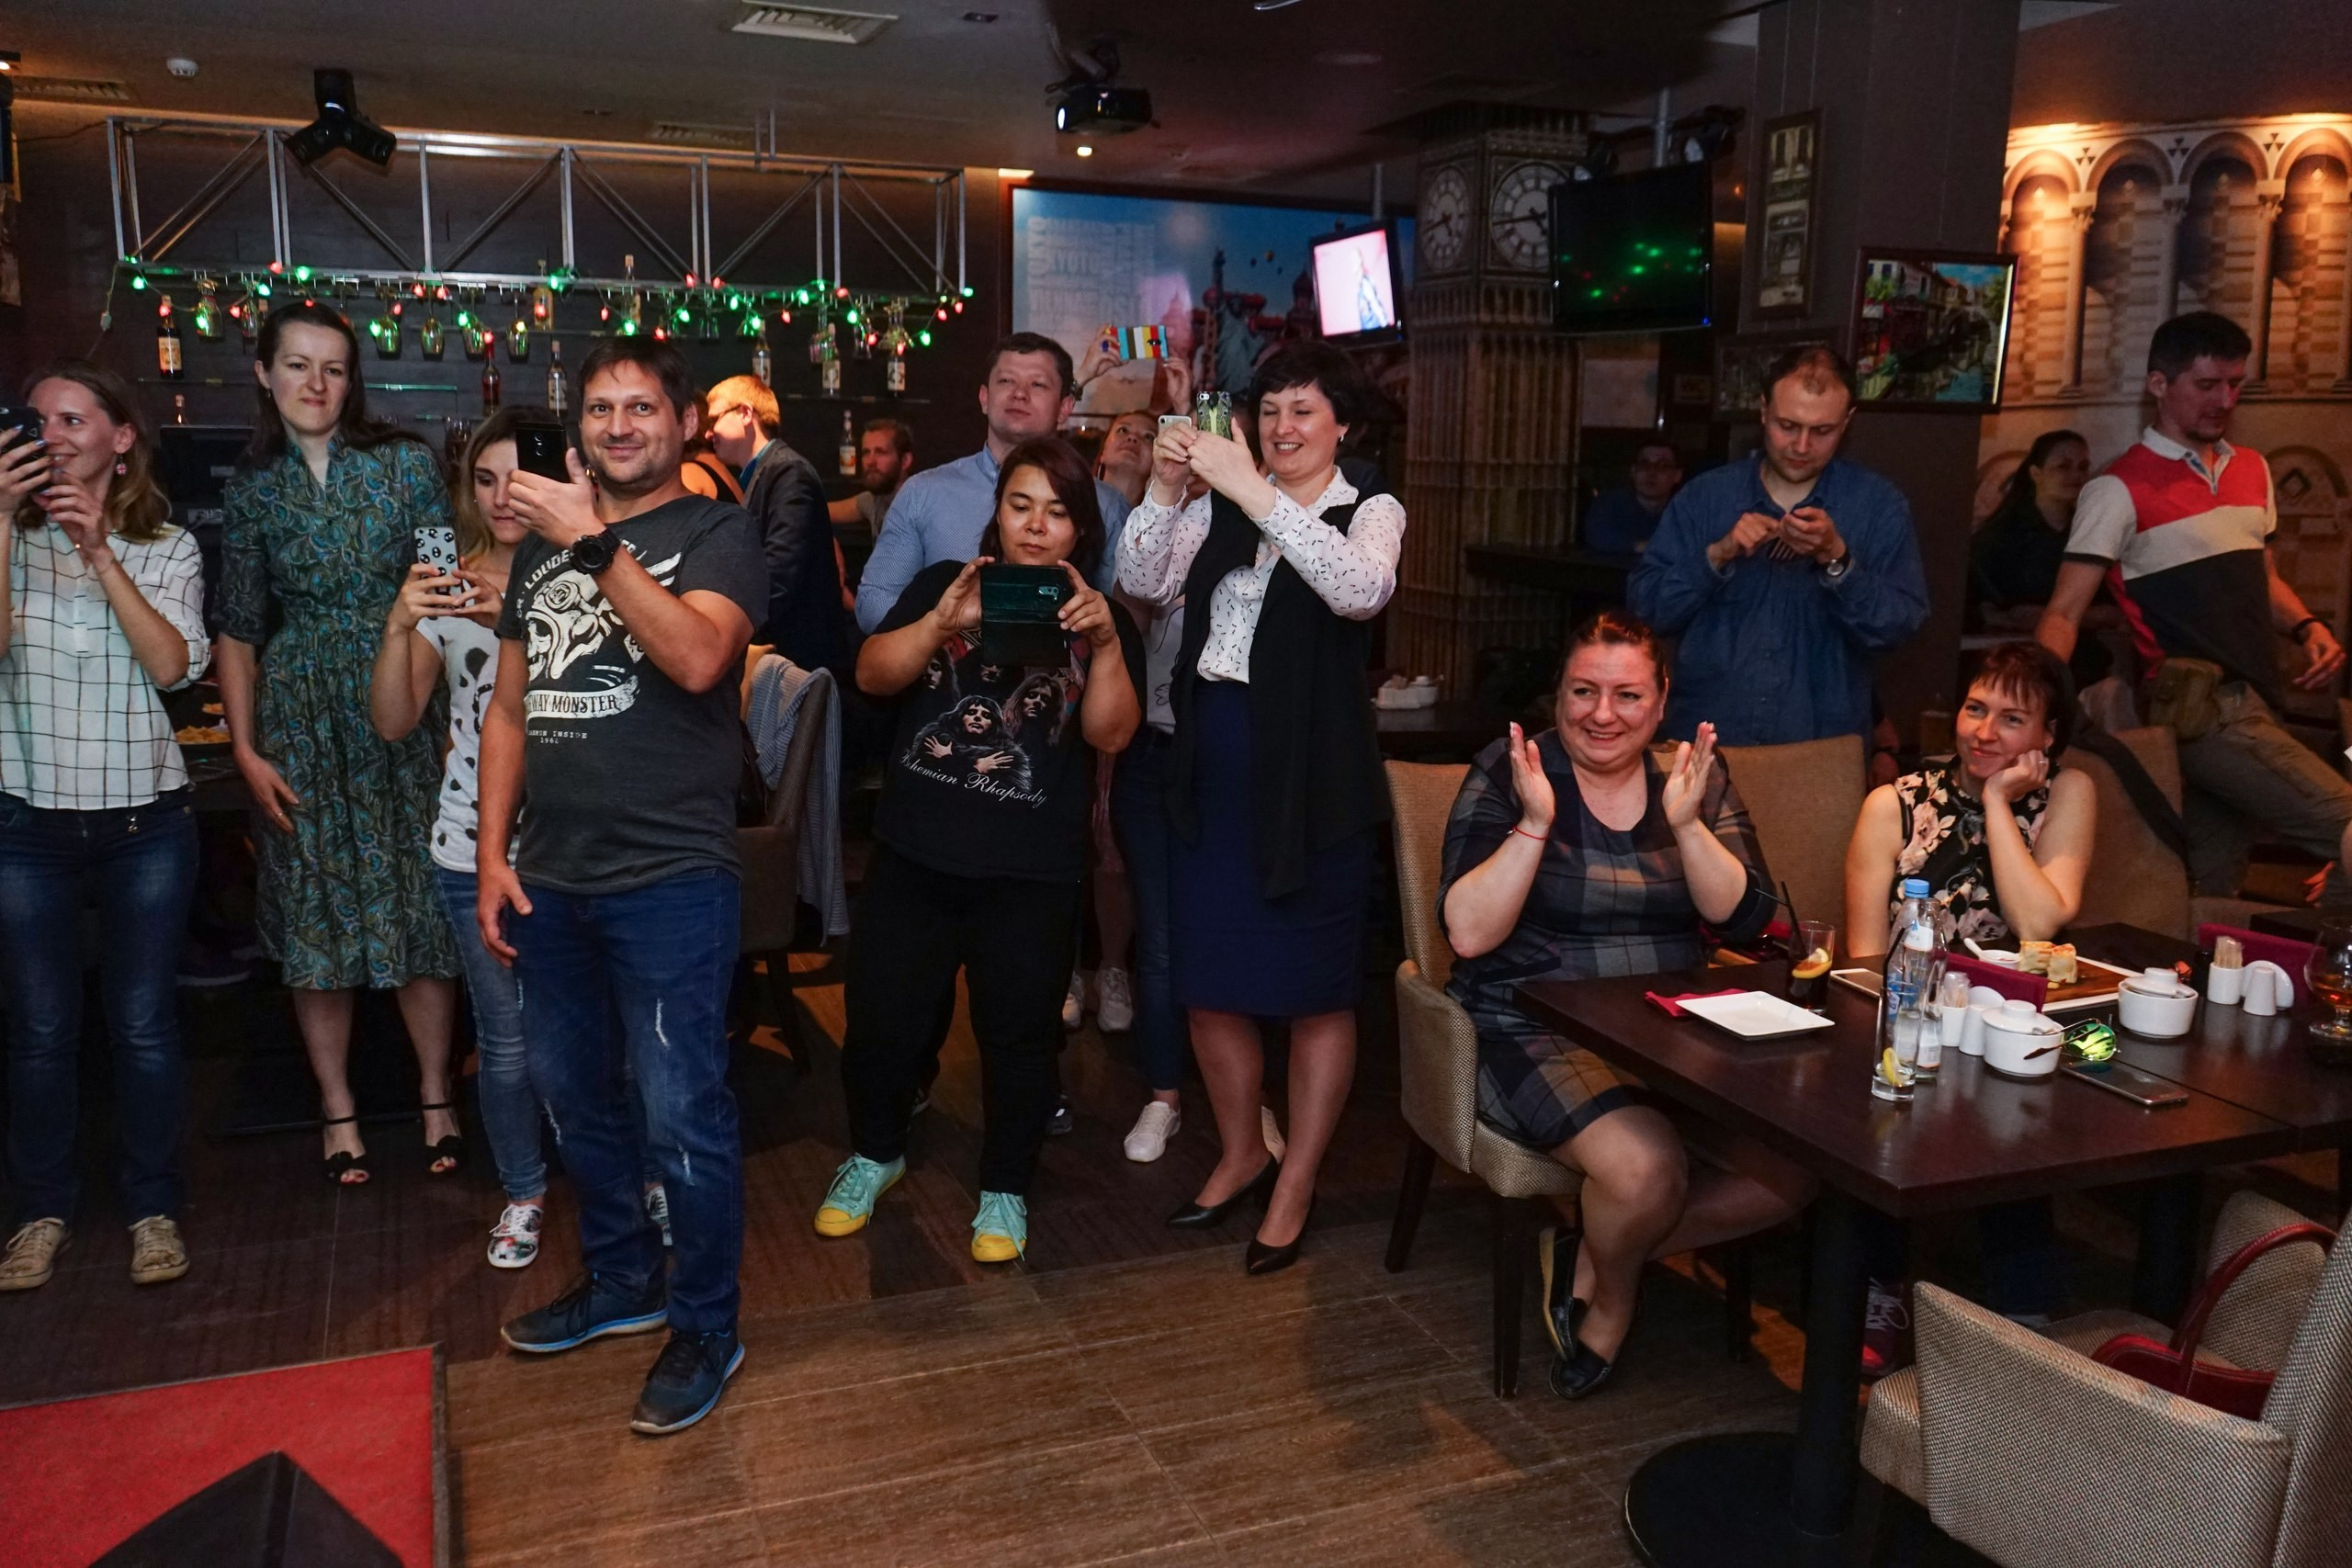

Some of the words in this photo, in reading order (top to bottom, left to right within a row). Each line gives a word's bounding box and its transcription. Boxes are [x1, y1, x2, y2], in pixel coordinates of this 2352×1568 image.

[525, 549, 574, 590] LOUDE
[551, 694, 621, 714] MONSTER
[899, 749, 958, 785] Bohemian
[964, 772, 1047, 809] Rhapsody
